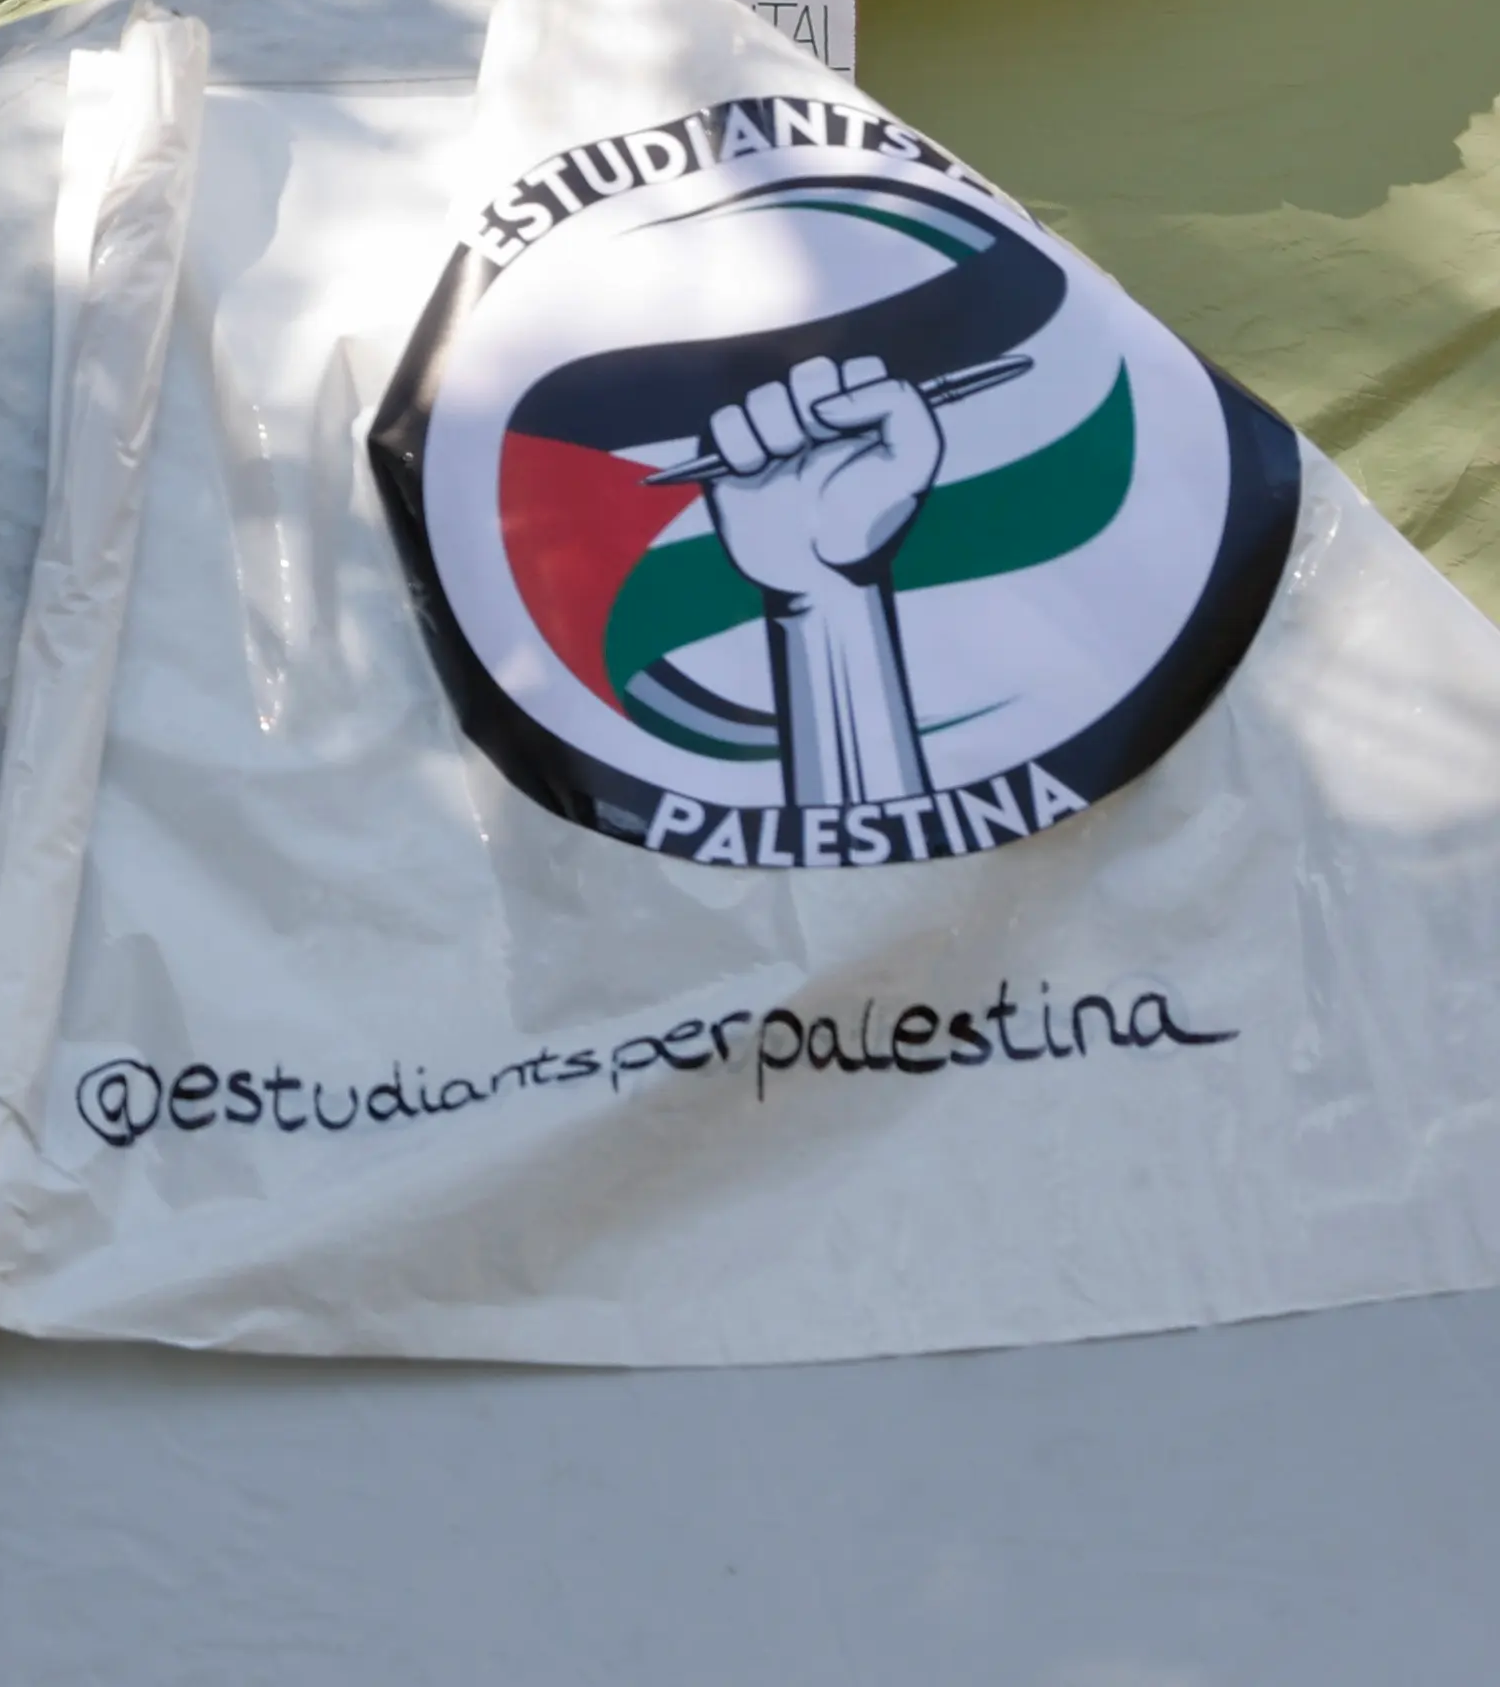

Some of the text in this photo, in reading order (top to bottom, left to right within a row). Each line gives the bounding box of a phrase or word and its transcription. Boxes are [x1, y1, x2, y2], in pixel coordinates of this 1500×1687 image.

[462, 97, 922, 266] ESTUDIANTS
[644, 760, 1089, 867] PALESTINA
[77, 979, 1240, 1148] @estudiantsperpalestina
